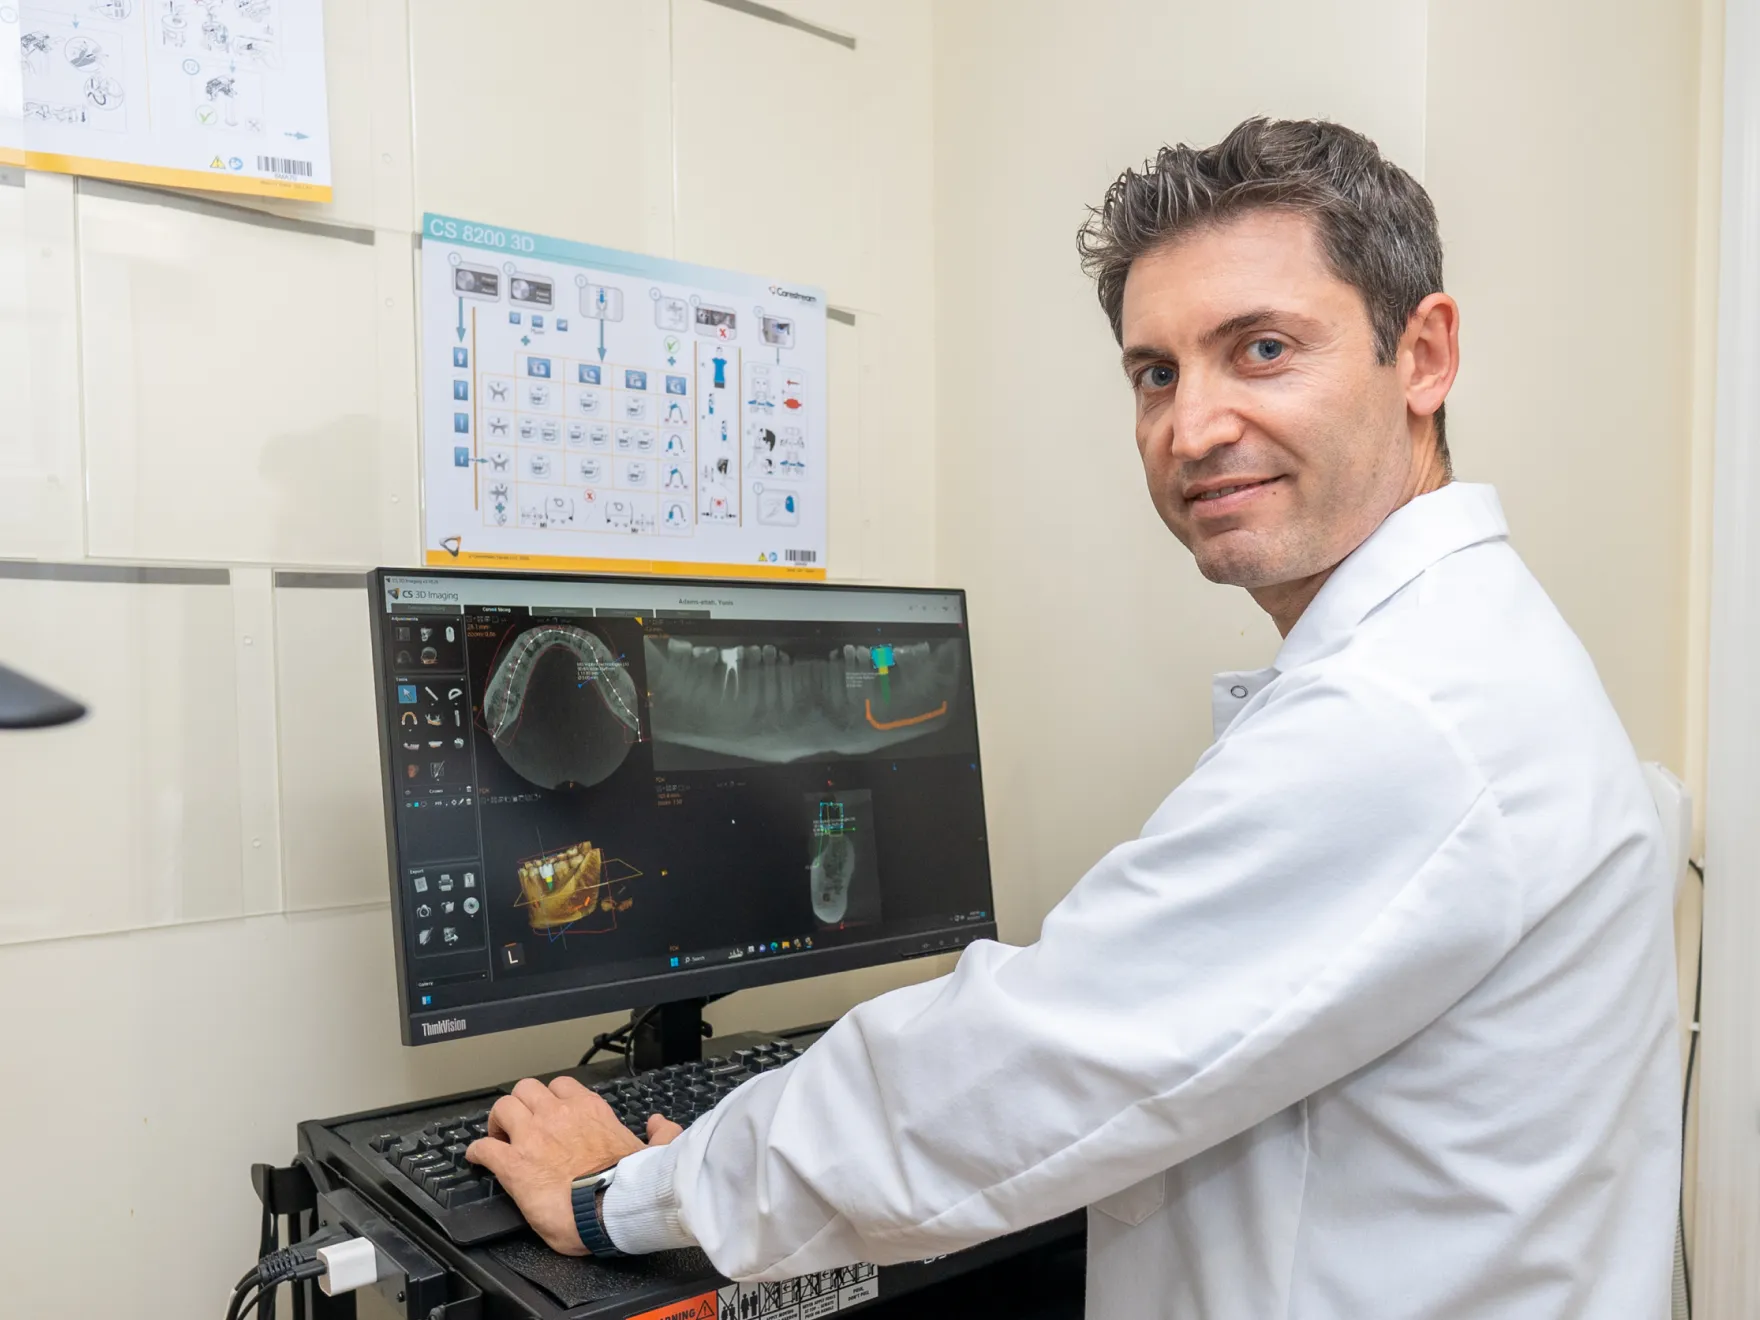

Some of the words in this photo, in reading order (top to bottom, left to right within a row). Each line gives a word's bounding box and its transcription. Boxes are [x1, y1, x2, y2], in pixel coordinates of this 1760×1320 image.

[430, 219, 457, 239] CS
[462, 225, 505, 248] 8200
[510, 234, 535, 252] 3D
[776, 287, 817, 302] Carestream
[402, 590, 413, 599] CS
[415, 591, 426, 599] 3D
[428, 590, 459, 601] Imaging
[508, 950, 518, 964] L
[422, 1018, 467, 1036] ThinkVision
[660, 1309, 696, 1320] NING
